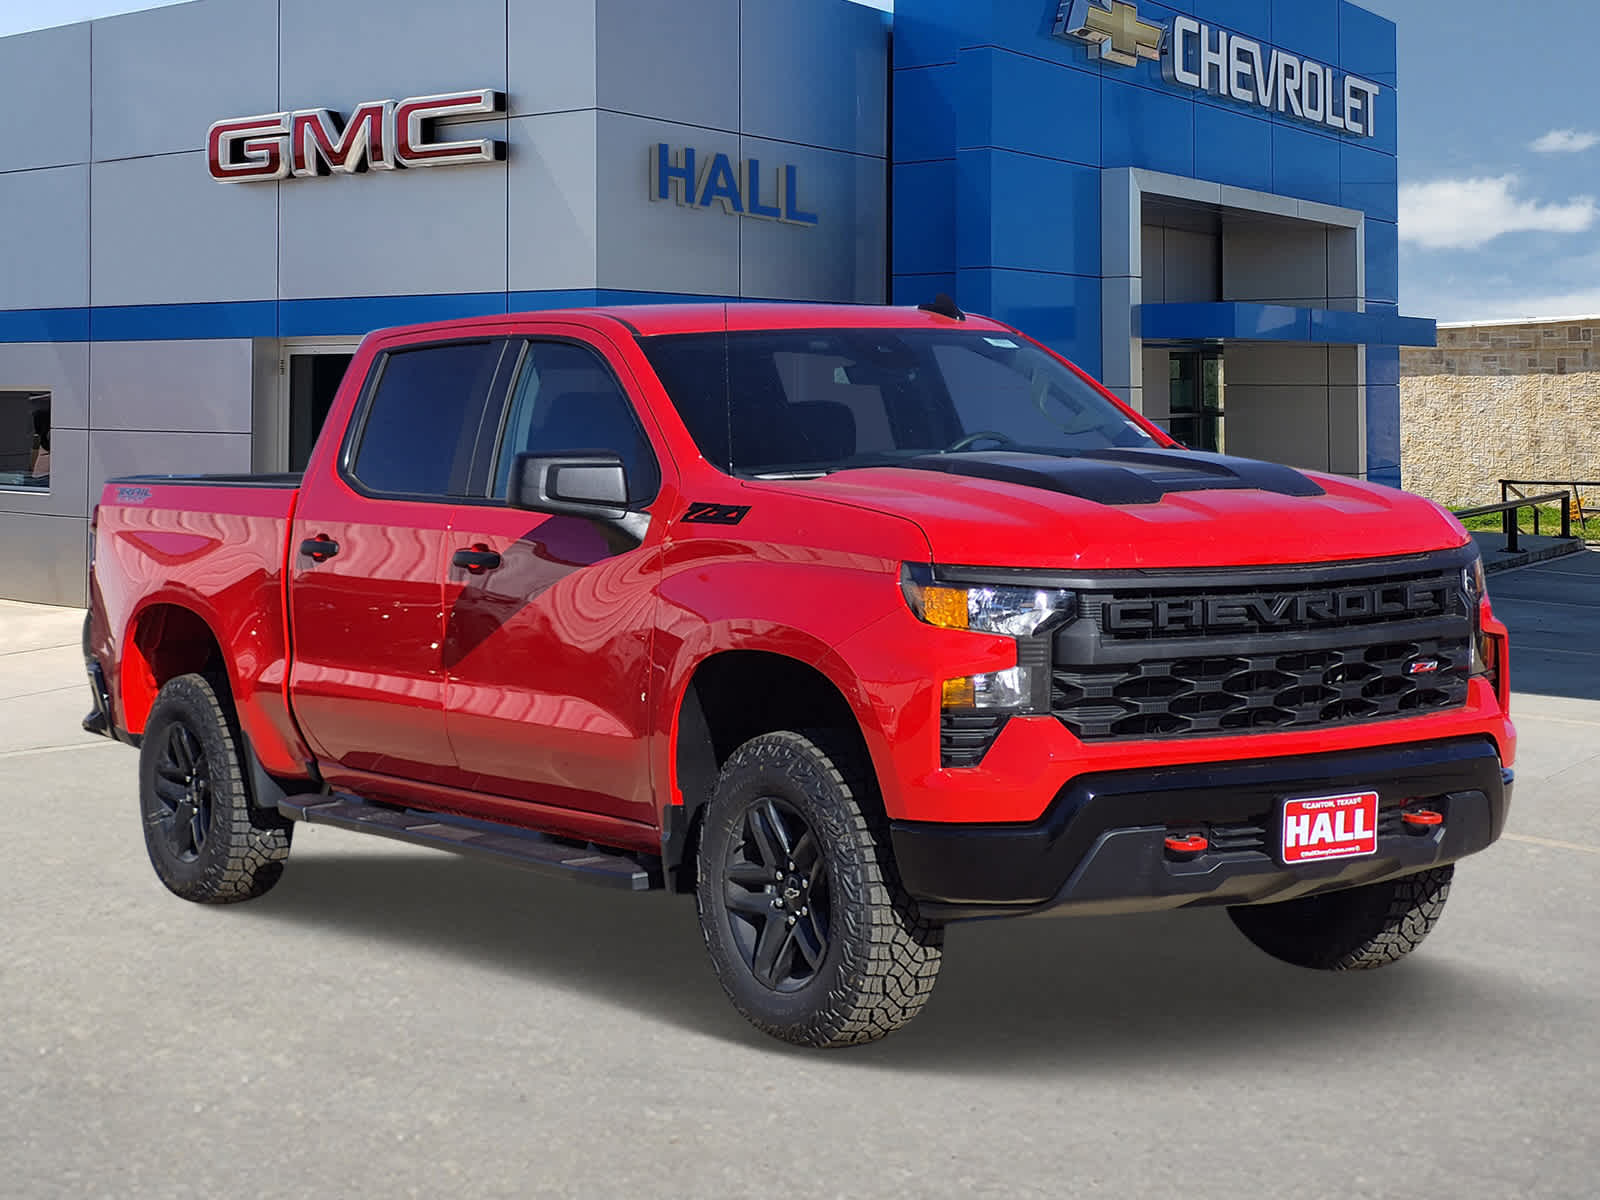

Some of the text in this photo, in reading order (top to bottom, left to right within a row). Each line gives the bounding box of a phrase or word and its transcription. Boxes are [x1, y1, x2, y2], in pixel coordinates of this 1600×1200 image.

[1173, 15, 1380, 137] CHEVROLET
[206, 89, 506, 184] GMC
[652, 143, 819, 226] HALL
[1286, 808, 1374, 848] HALL
